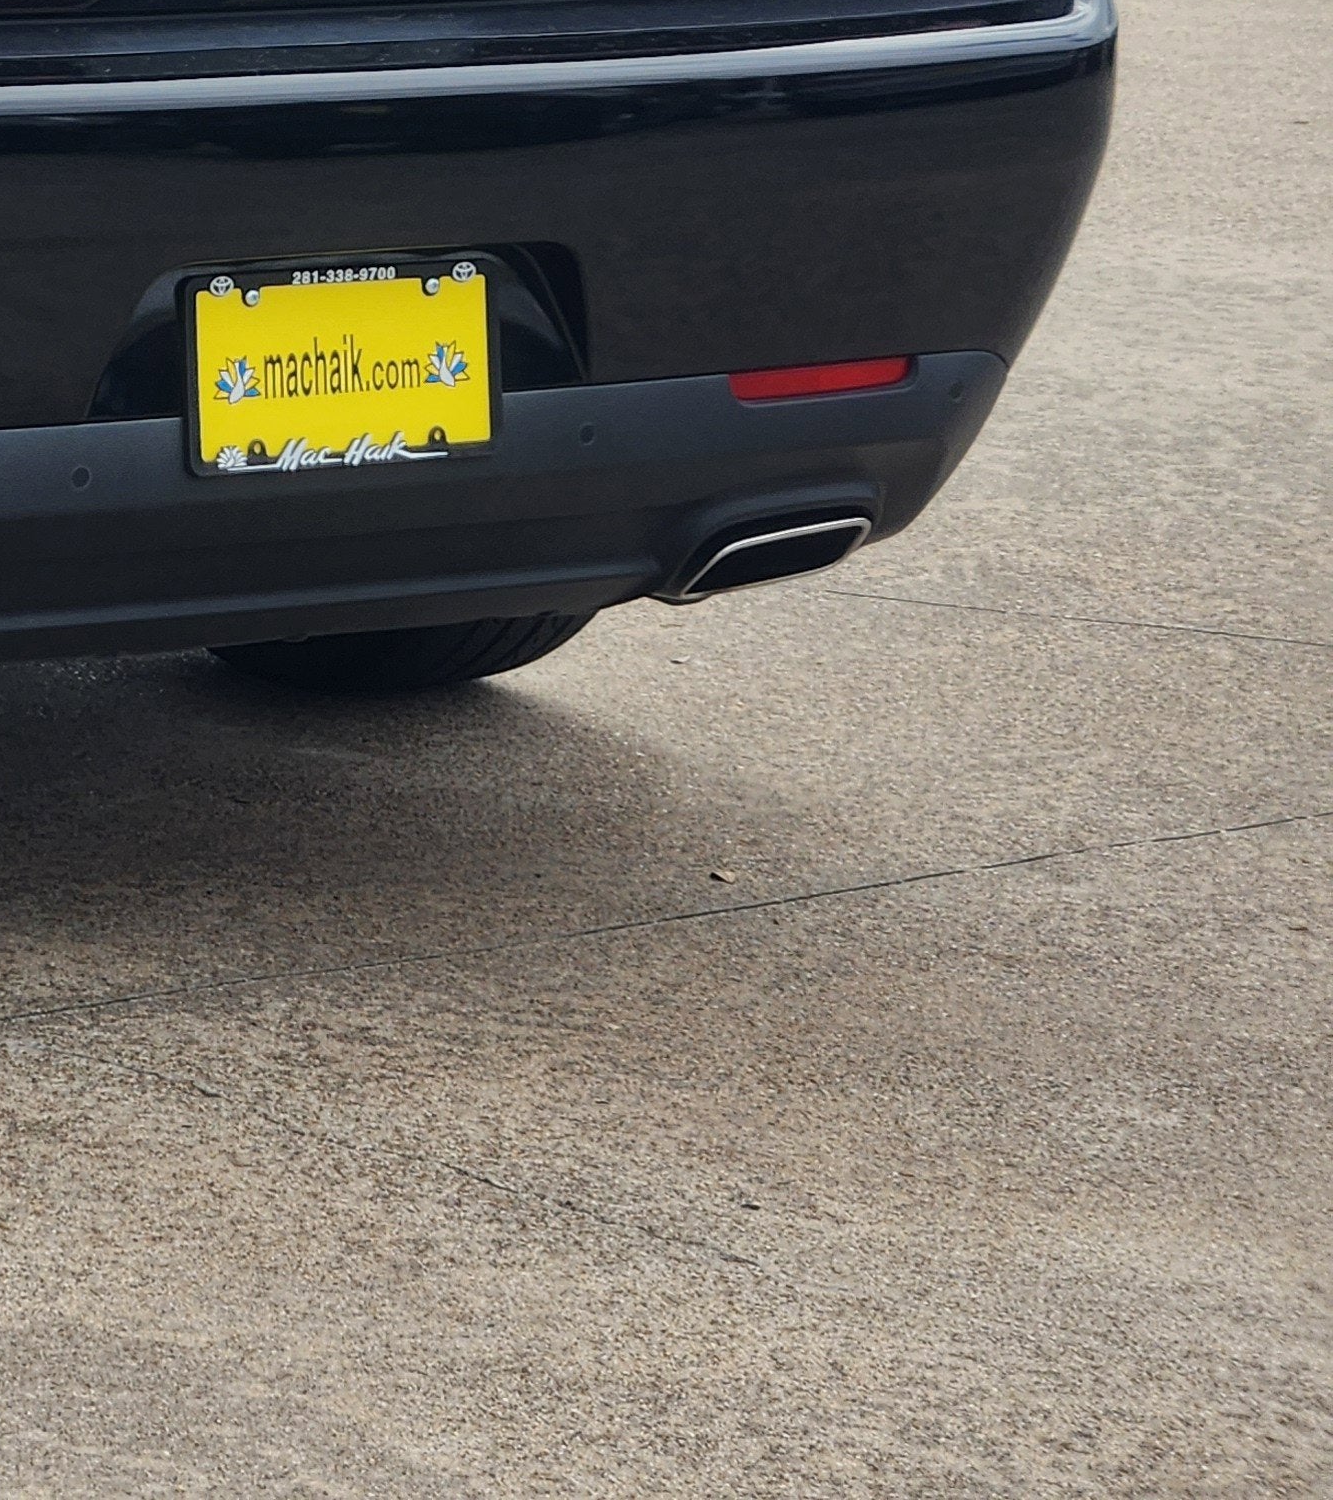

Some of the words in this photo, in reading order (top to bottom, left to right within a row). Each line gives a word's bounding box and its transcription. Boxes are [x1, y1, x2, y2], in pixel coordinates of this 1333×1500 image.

[291, 265, 397, 285] 281-338-9700
[263, 333, 422, 400] machaik.com
[275, 437, 343, 473] Mac
[342, 432, 449, 468] Haik
